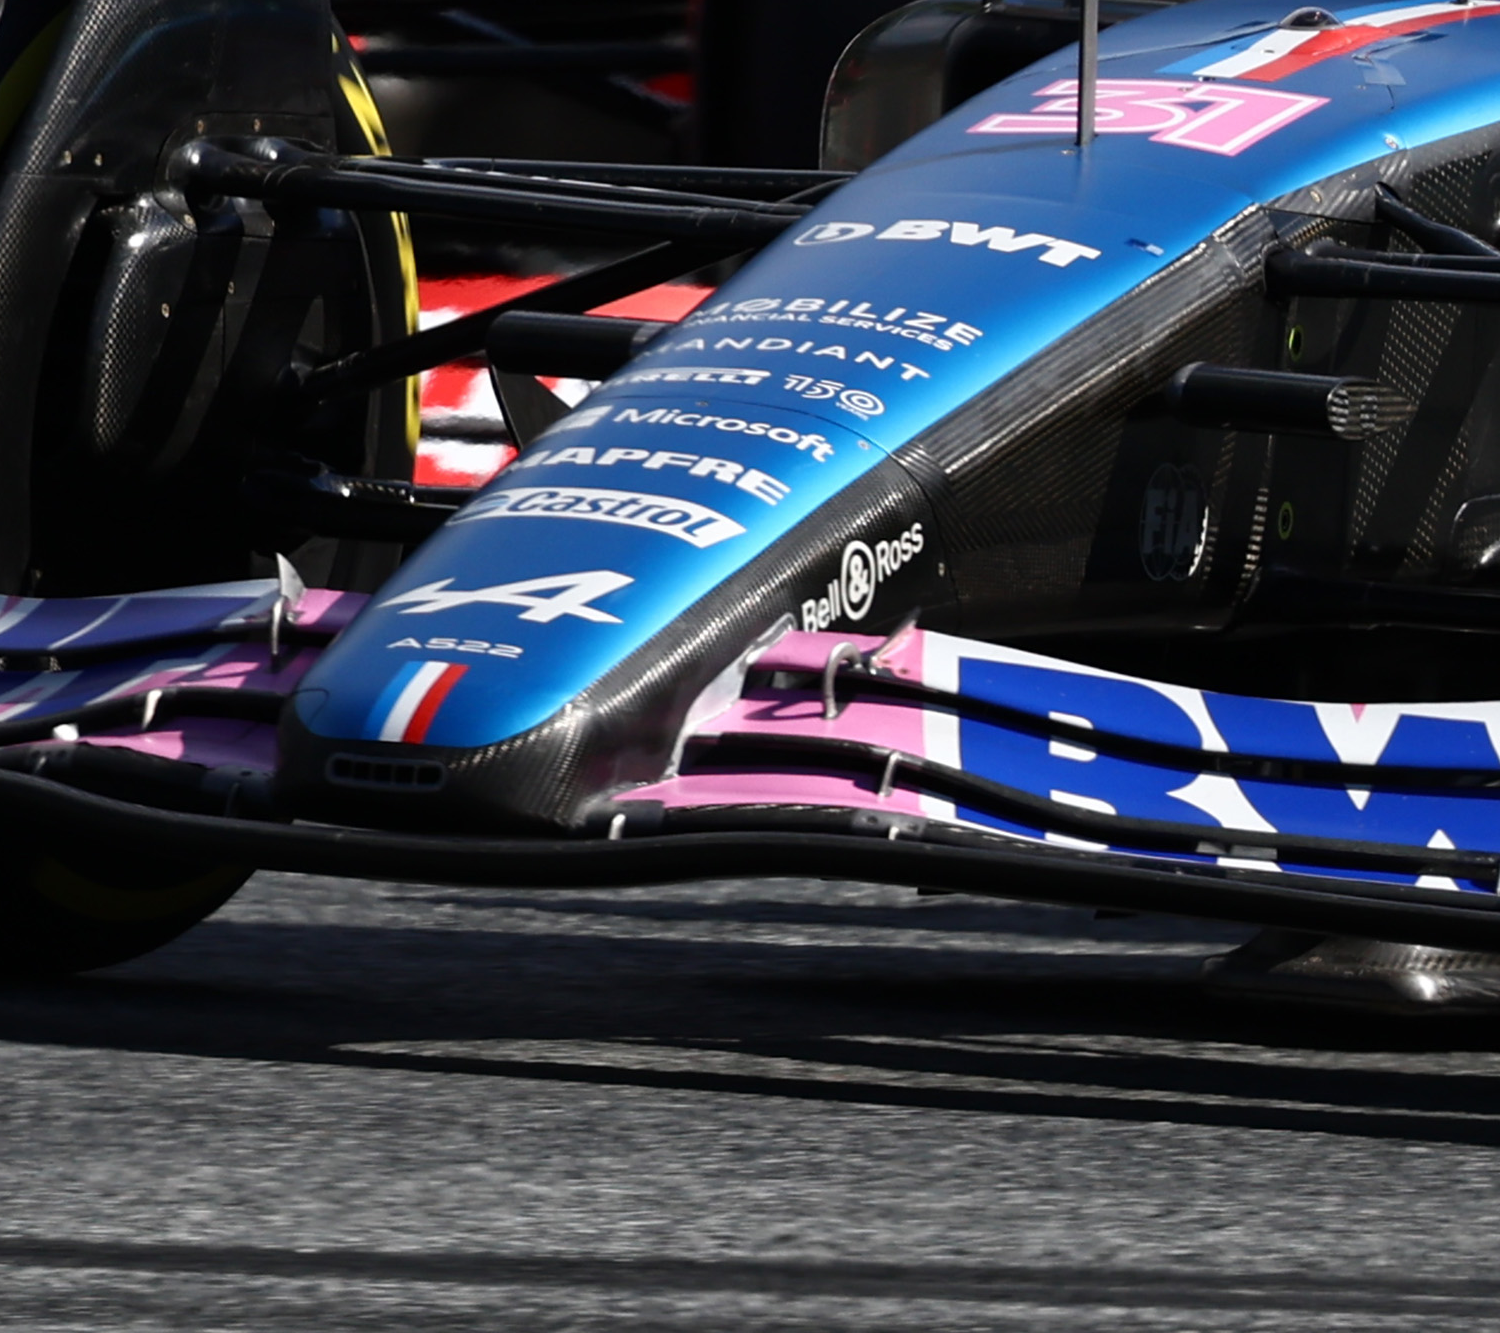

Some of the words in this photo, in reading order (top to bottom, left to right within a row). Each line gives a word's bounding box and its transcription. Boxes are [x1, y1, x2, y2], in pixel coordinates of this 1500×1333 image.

[966, 79, 1331, 157] 31
[875, 220, 1101, 267] BWT
[818, 315, 953, 351] SERVICES
[613, 408, 835, 463] Microsoft
[508, 490, 719, 537] Castrol
[802, 579, 841, 633] Bell
[875, 522, 924, 583] Ross
[386, 637, 523, 659] A522
